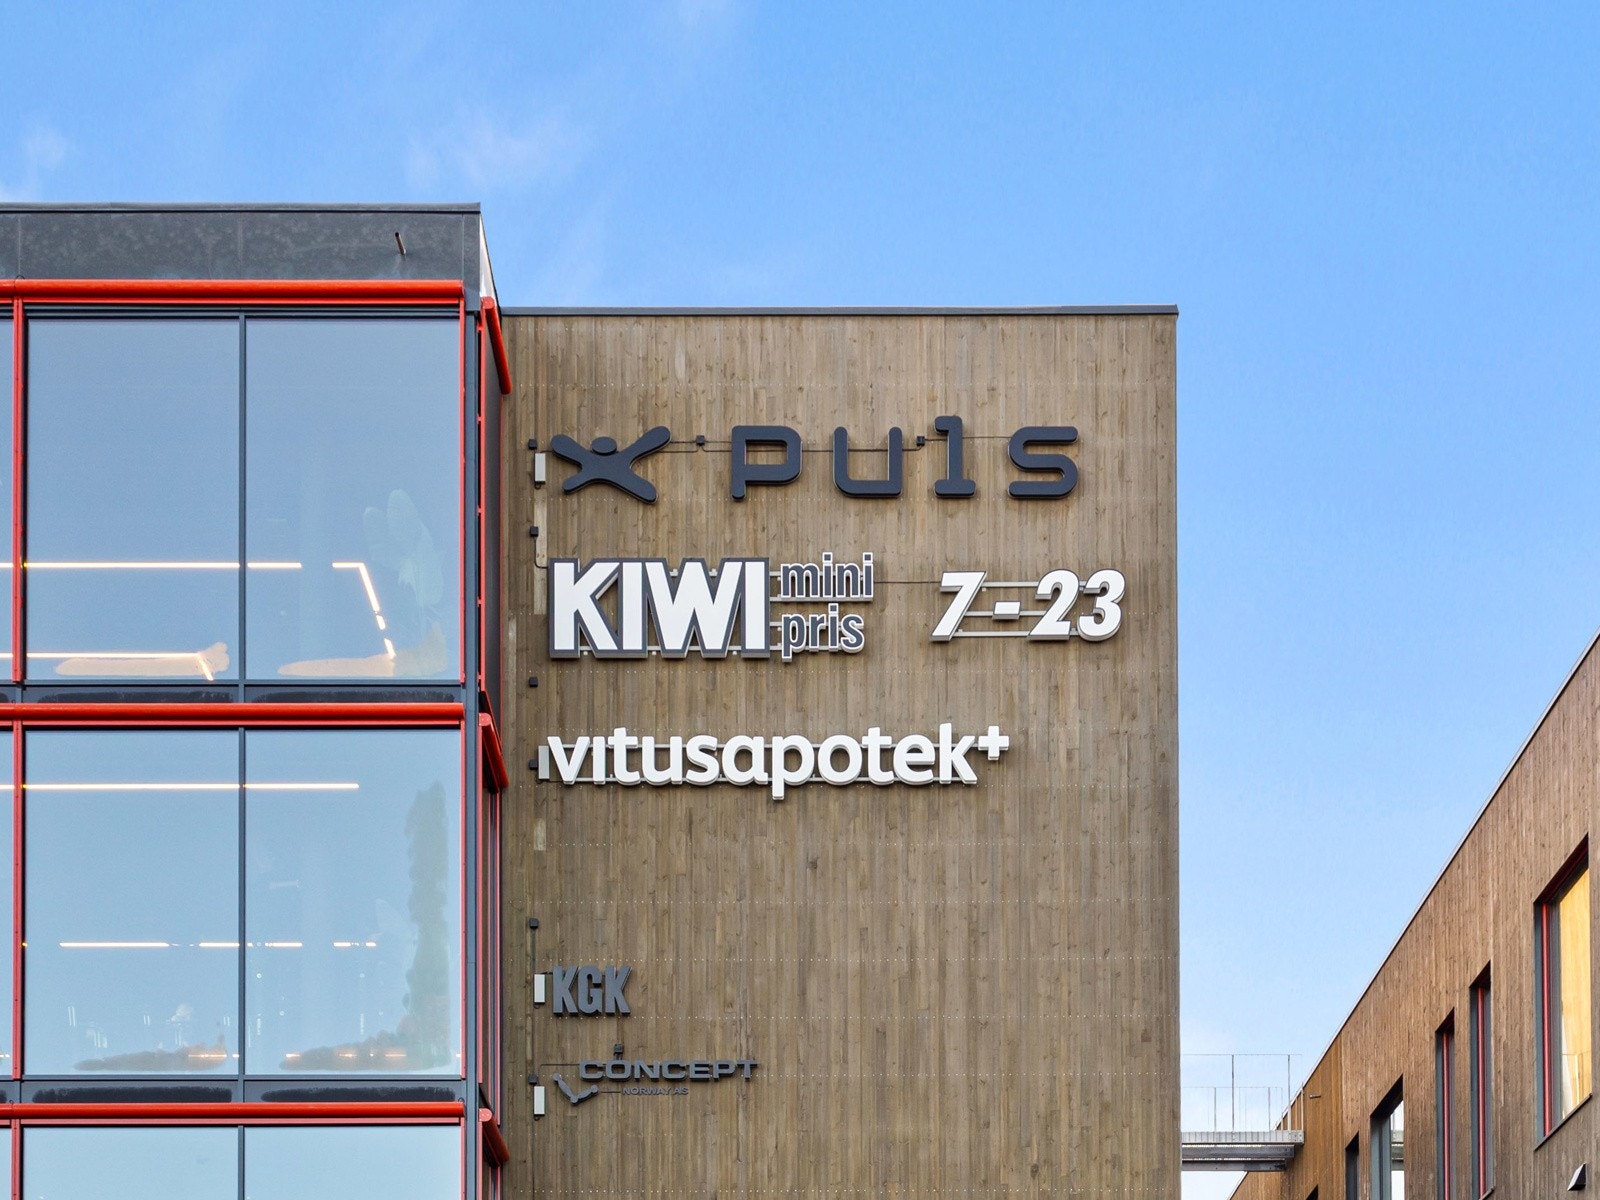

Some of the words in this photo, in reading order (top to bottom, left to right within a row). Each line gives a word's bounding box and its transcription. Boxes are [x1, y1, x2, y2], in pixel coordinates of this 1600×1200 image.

[731, 415, 1079, 500] puls
[779, 552, 874, 602] mini
[549, 557, 771, 659] KIWI
[781, 603, 865, 662] pris
[551, 965, 632, 1016] KGK
[579, 1059, 757, 1081] CONCEPT
[622, 1087, 671, 1096] NORWAY
[673, 1087, 689, 1096] AS
